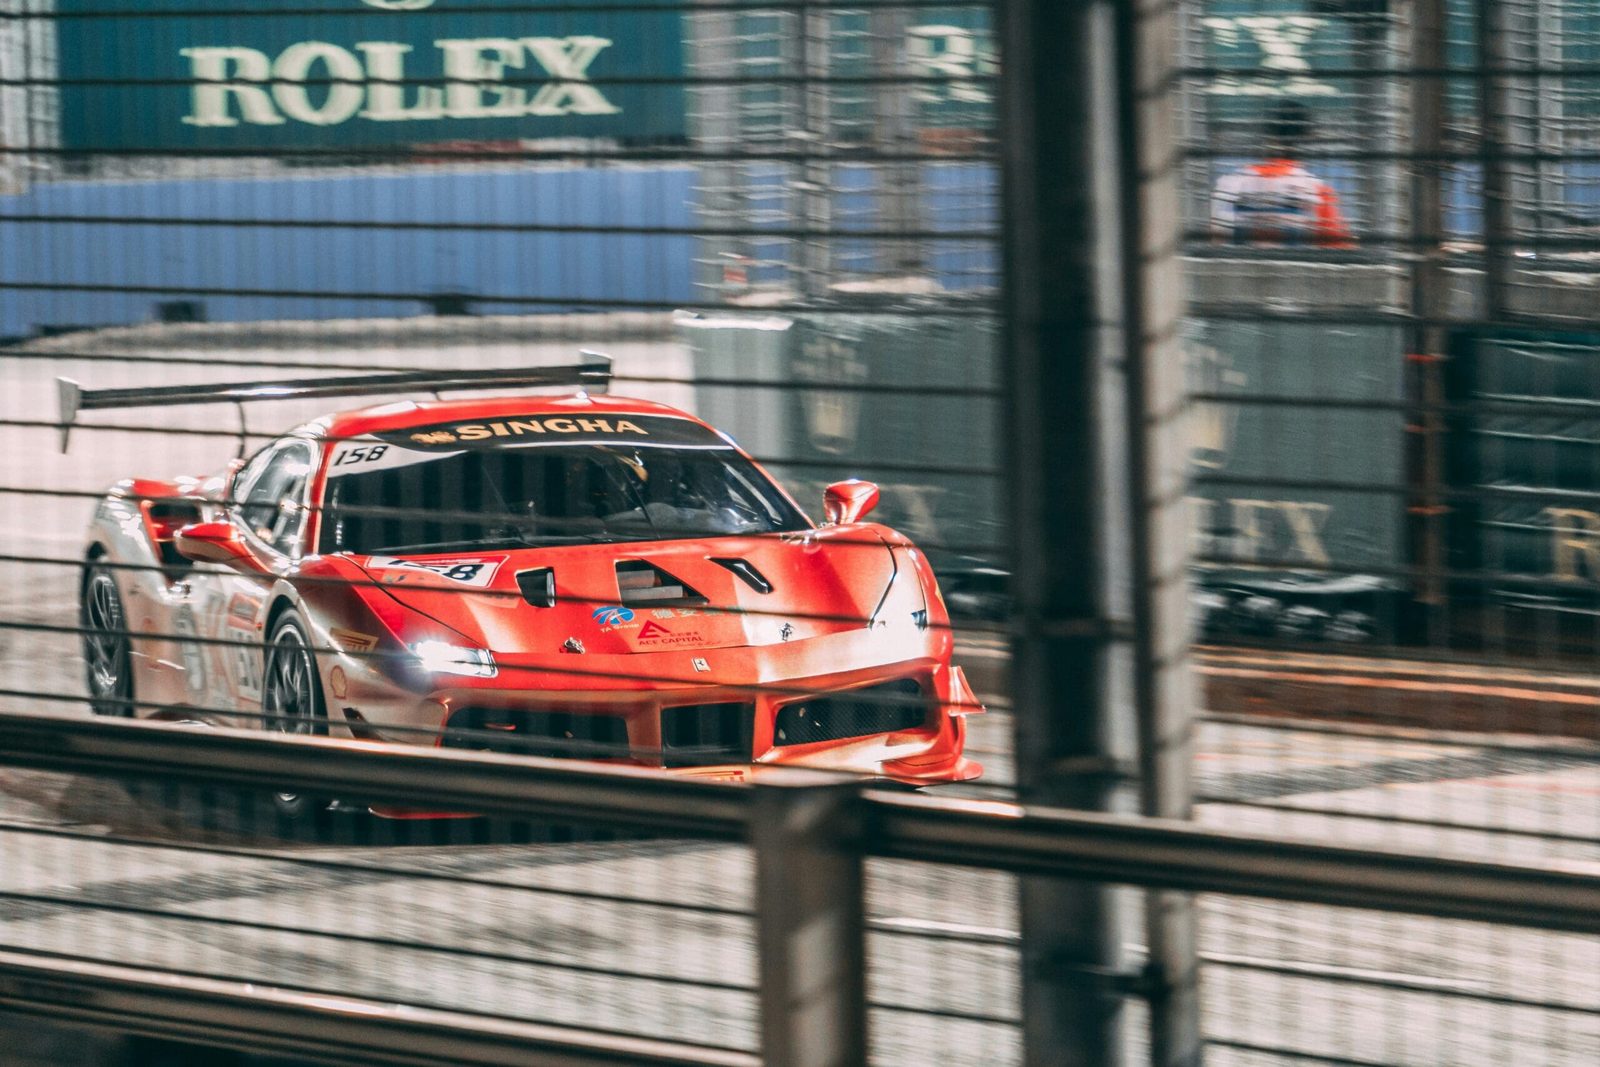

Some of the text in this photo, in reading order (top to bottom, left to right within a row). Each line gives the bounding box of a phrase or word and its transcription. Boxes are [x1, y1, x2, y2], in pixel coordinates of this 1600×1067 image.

[180, 36, 621, 127] ROLEX
[455, 418, 648, 441] SINGHA
[334, 445, 388, 467] 158
[661, 636, 705, 645] CAPITAL
